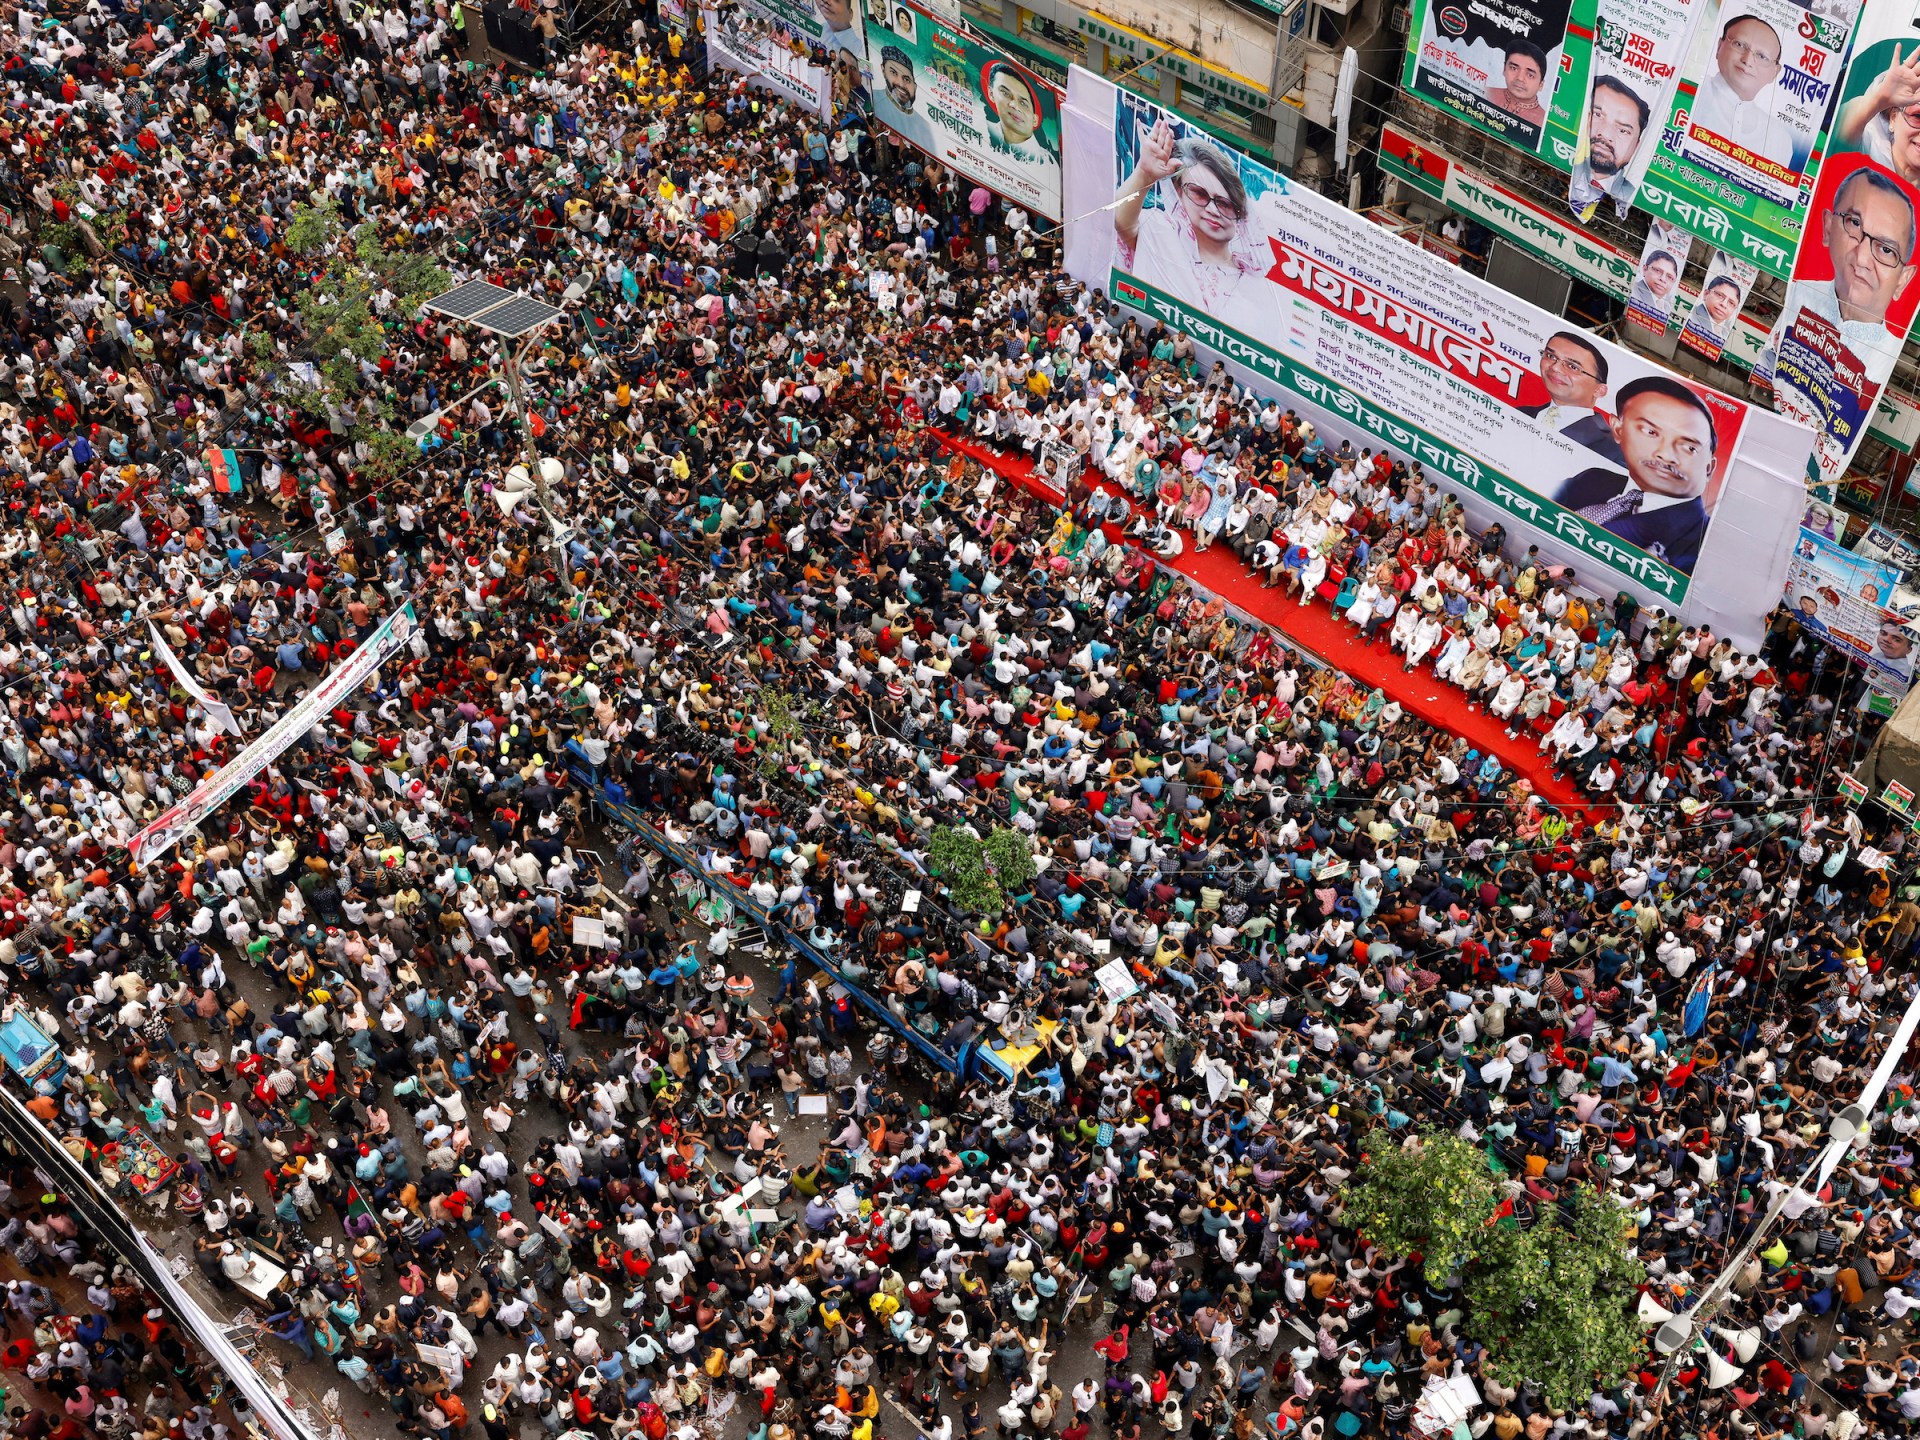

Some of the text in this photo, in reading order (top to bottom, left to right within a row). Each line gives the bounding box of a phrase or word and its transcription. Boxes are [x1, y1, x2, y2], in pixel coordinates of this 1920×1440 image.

[932, 32, 966, 59] BACK
[937, 27, 957, 45] TAKE
[1627, 32, 1656, 57] মহা
[1797, 11, 1849, 42] ১ দফা
[932, 42, 966, 65] BANGLADESH
[1077, 17, 1268, 110] PUBALI BANK LIMITED
[1799, 44, 1828, 77] মহা
[1426, 74, 1477, 107] জাতীয়তাবাদী
[1519, 123, 1534, 137] দল
[1778, 63, 1831, 107] সমাবেশ
[926, 103, 983, 146] বাংলাদেশ
[956, 146, 985, 168] হামিদুর
[987, 165, 1014, 183] রহমান
[1017, 179, 1041, 198] হামিদ
[1731, 144, 1755, 167] মীর
[1678, 165, 1746, 208] খালেদা জিয়া
[1455, 177, 1568, 249] বাংলাদেশ
[1277, 227, 1310, 251] যুগপৎ
[1313, 244, 1344, 270] ধারায়
[1386, 284, 1477, 336] গণ-আন্দোলনের
[1479, 320, 1495, 346] ১
[1499, 341, 1532, 365] দফার
[1428, 278, 1448, 295] বেগম
[1449, 288, 1473, 310] খালেদা
[1473, 298, 1490, 318] জিয়া
[1480, 295, 1507, 315] সরকারের
[1508, 307, 1531, 327] পদত্যাগ
[1279, 244, 1525, 400] মহাসমাবেশ
[1315, 350, 1341, 371] আমান
[1366, 375, 1394, 400] আমান,
[1318, 337, 1342, 359] মির্জা
[1410, 388, 1432, 408] জাতীয়
[1447, 408, 1468, 426] কমিটি
[1467, 420, 1492, 440] বিএনপি
[1319, 325, 1344, 346] জাতীয়
[1346, 340, 1365, 358] স্থায়ী
[1366, 350, 1397, 373] কমিটির
[1436, 387, 1443, 398] ও
[1444, 392, 1471, 414] জাতীয়
[1320, 310, 1575, 456] মির্জা ফখরুল ইসলাম আলমগীর, মহাসচিব, বিএনপি
[1150, 294, 1683, 598] বাংলাদেশ জাতীয়তাবাদী দল-বিএনপি
